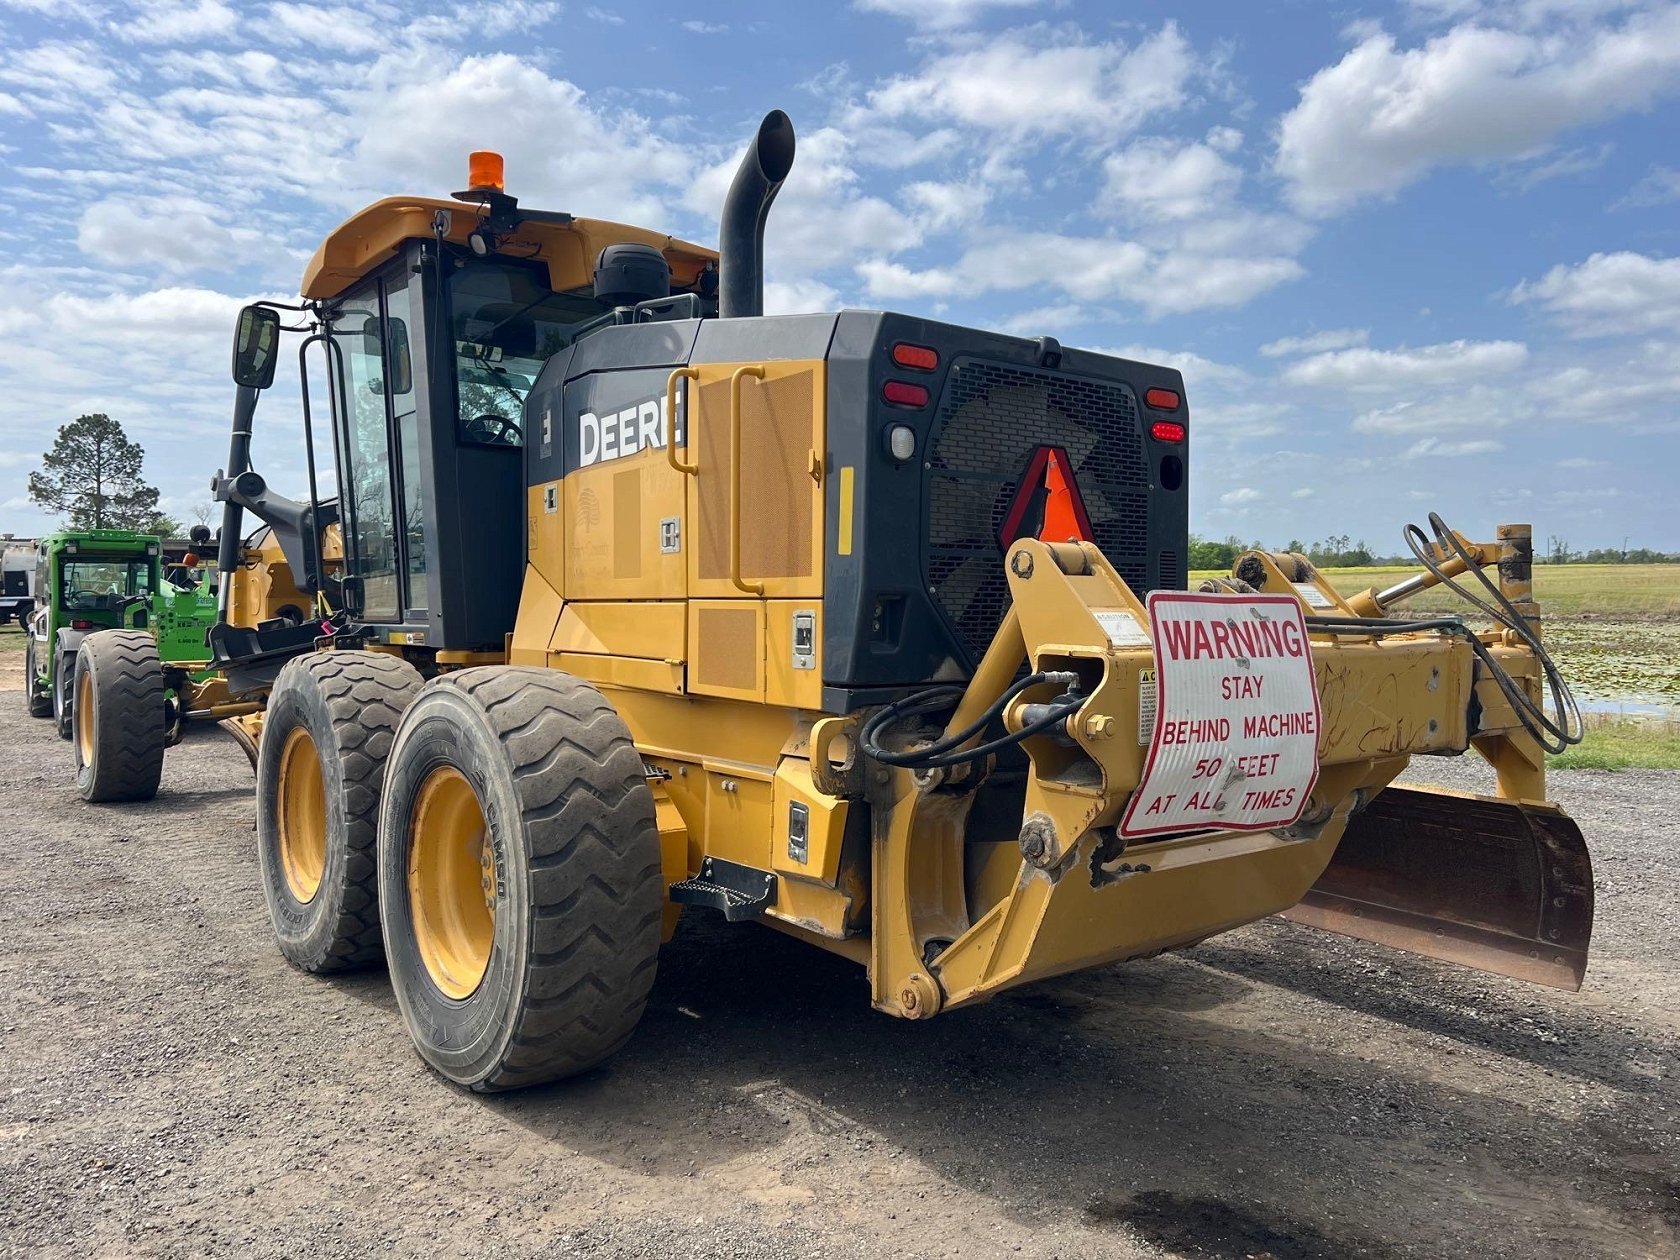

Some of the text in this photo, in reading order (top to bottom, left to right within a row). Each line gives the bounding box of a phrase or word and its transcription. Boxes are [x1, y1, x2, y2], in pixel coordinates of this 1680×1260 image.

[579, 391, 681, 468] DEERE
[1161, 619, 1303, 661] WARNING
[1221, 675, 1264, 701] STAY
[1162, 712, 1315, 745] BEHIND MACHINE
[1191, 754, 1280, 780] 50 FEET
[1144, 794, 1177, 816] AT
[1242, 787, 1297, 811] TIMES
